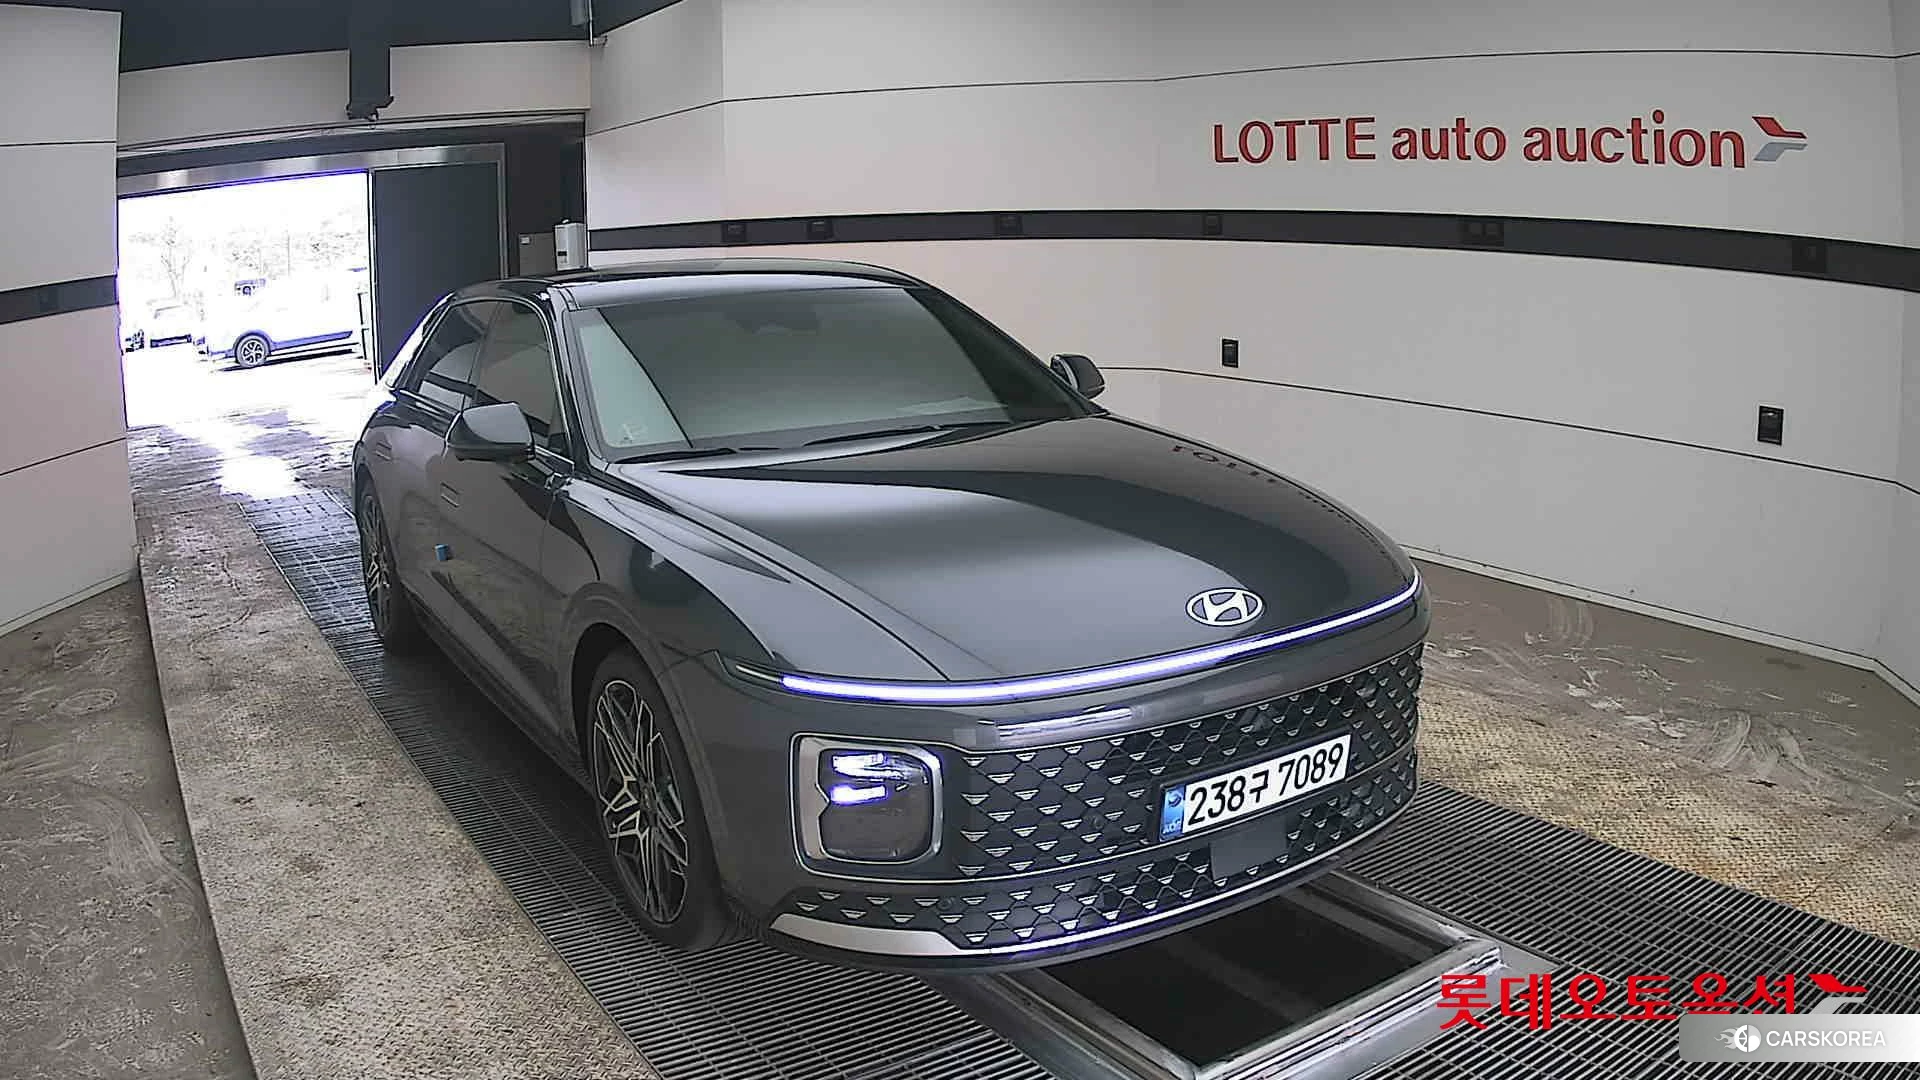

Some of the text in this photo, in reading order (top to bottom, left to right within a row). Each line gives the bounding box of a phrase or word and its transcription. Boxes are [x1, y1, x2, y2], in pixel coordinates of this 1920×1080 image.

[1213, 109, 1746, 169] LOTTE auto auction
[1187, 742, 1344, 827] 238구 7089
